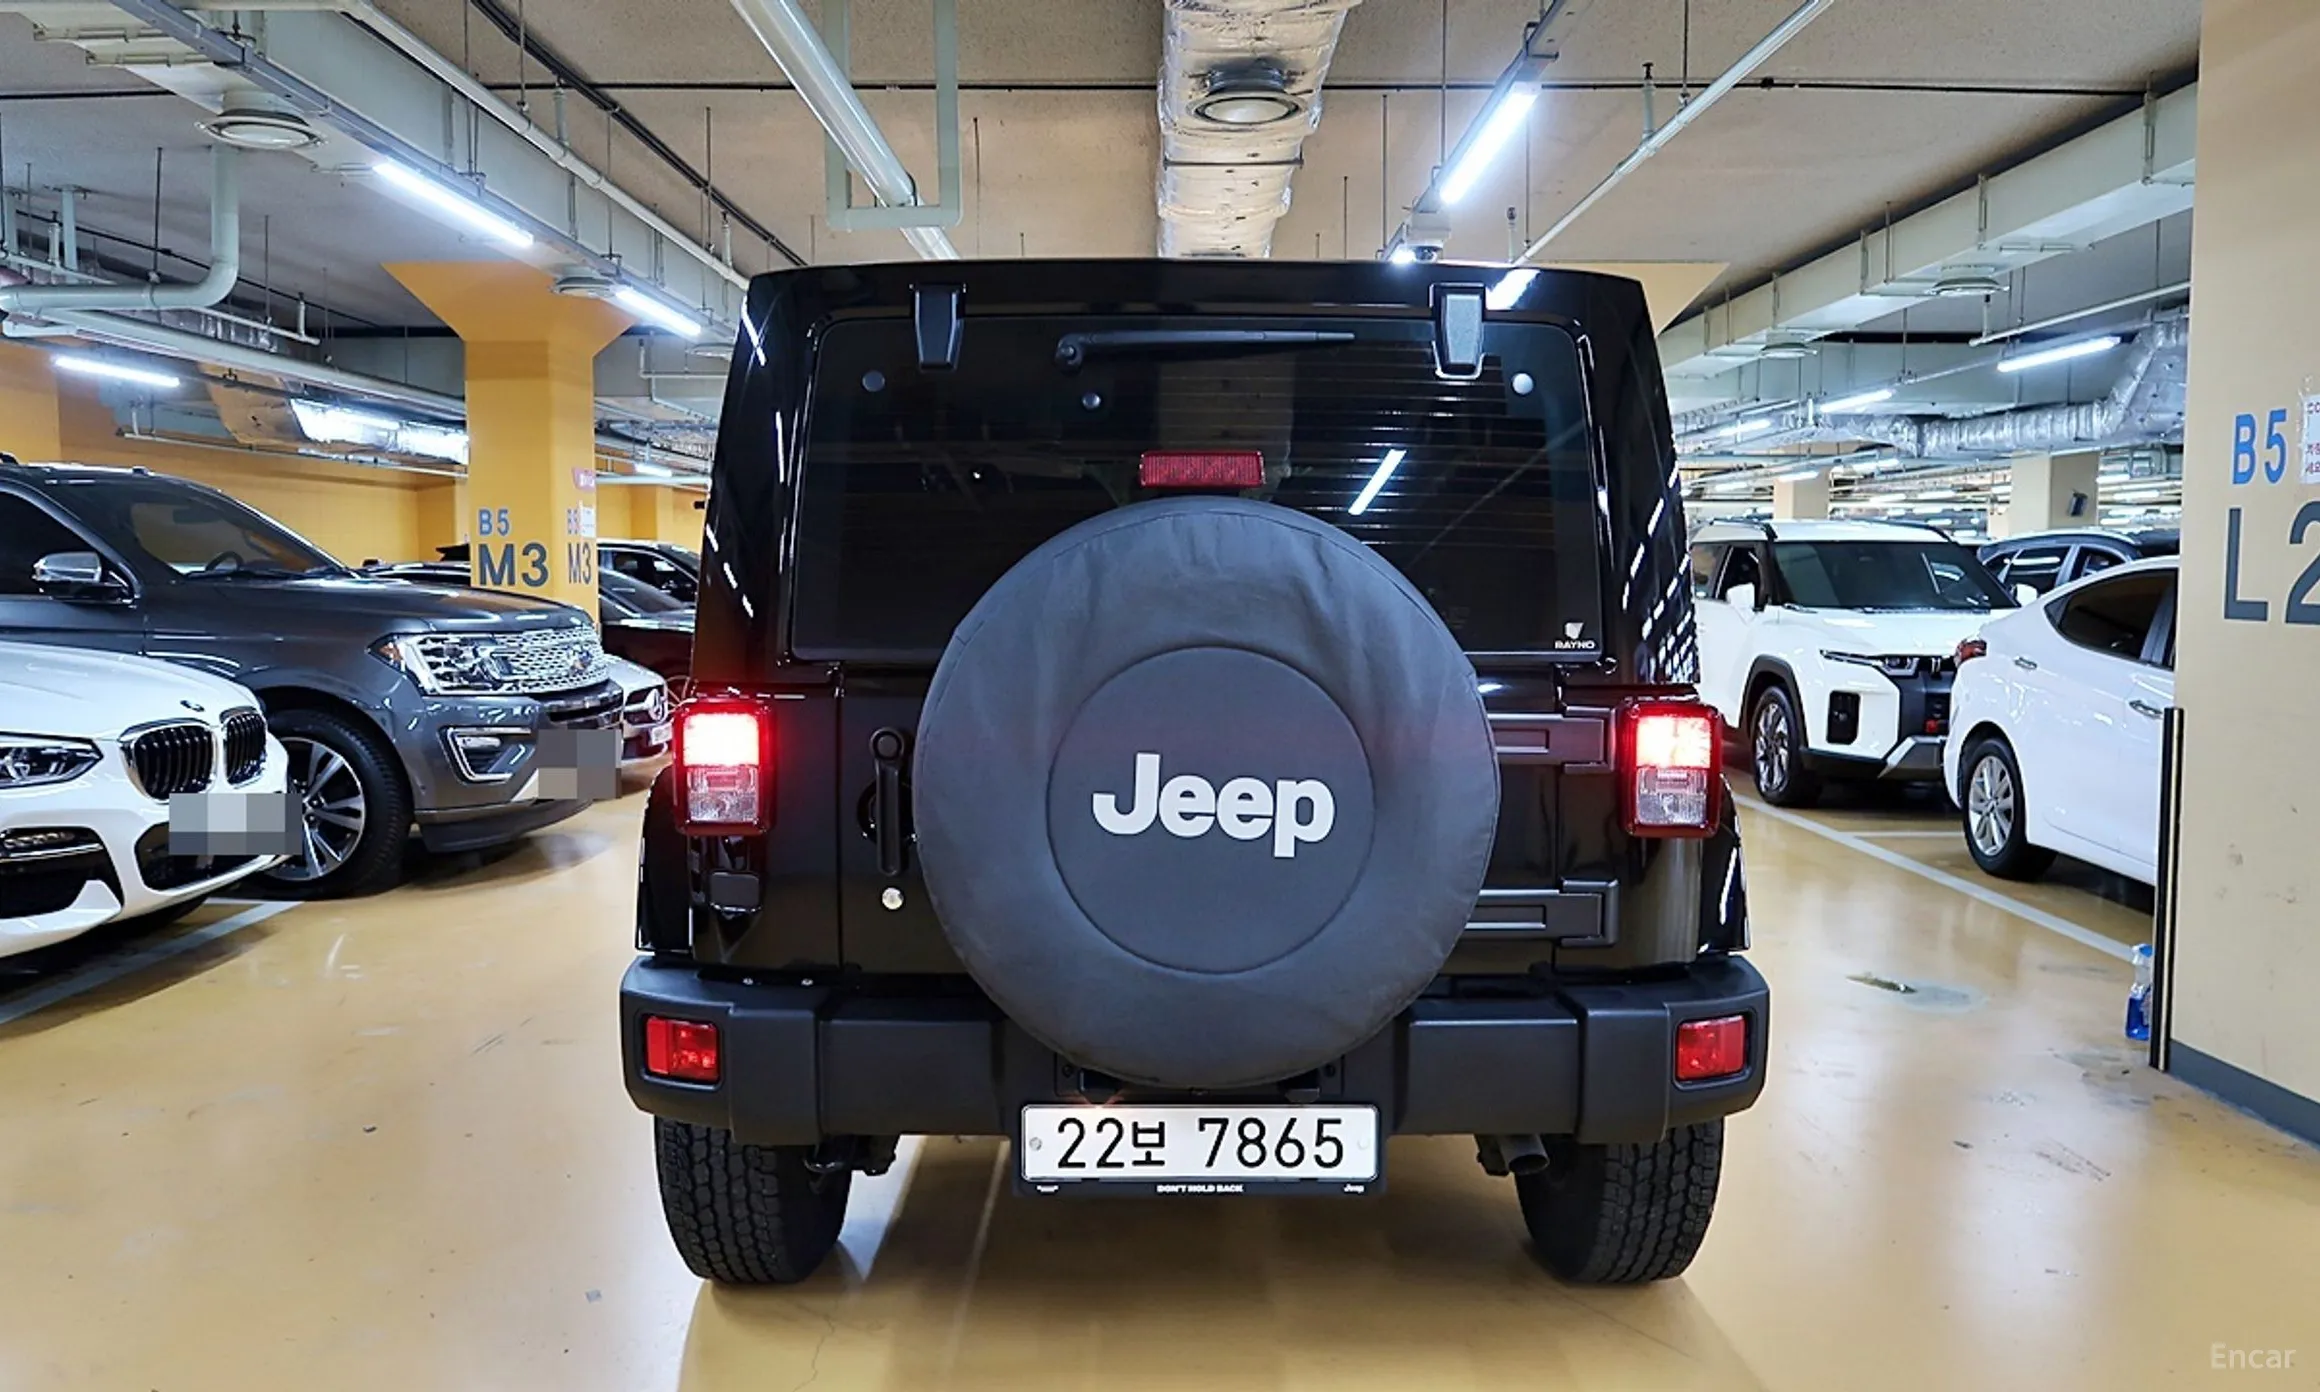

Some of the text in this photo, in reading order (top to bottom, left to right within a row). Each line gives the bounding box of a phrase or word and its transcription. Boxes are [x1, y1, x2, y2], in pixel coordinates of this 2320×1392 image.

[2232, 408, 2288, 485] B5
[478, 507, 510, 536] B5
[478, 542, 549, 587] M3
[567, 541, 592, 585] M3
[2224, 500, 2320, 625] L2
[1554, 640, 1596, 649] RAYNO
[1092, 752, 1335, 858] Jeep
[1057, 1117, 1344, 1169] 22보 7865
[1216, 1184, 1244, 1193] BACK
